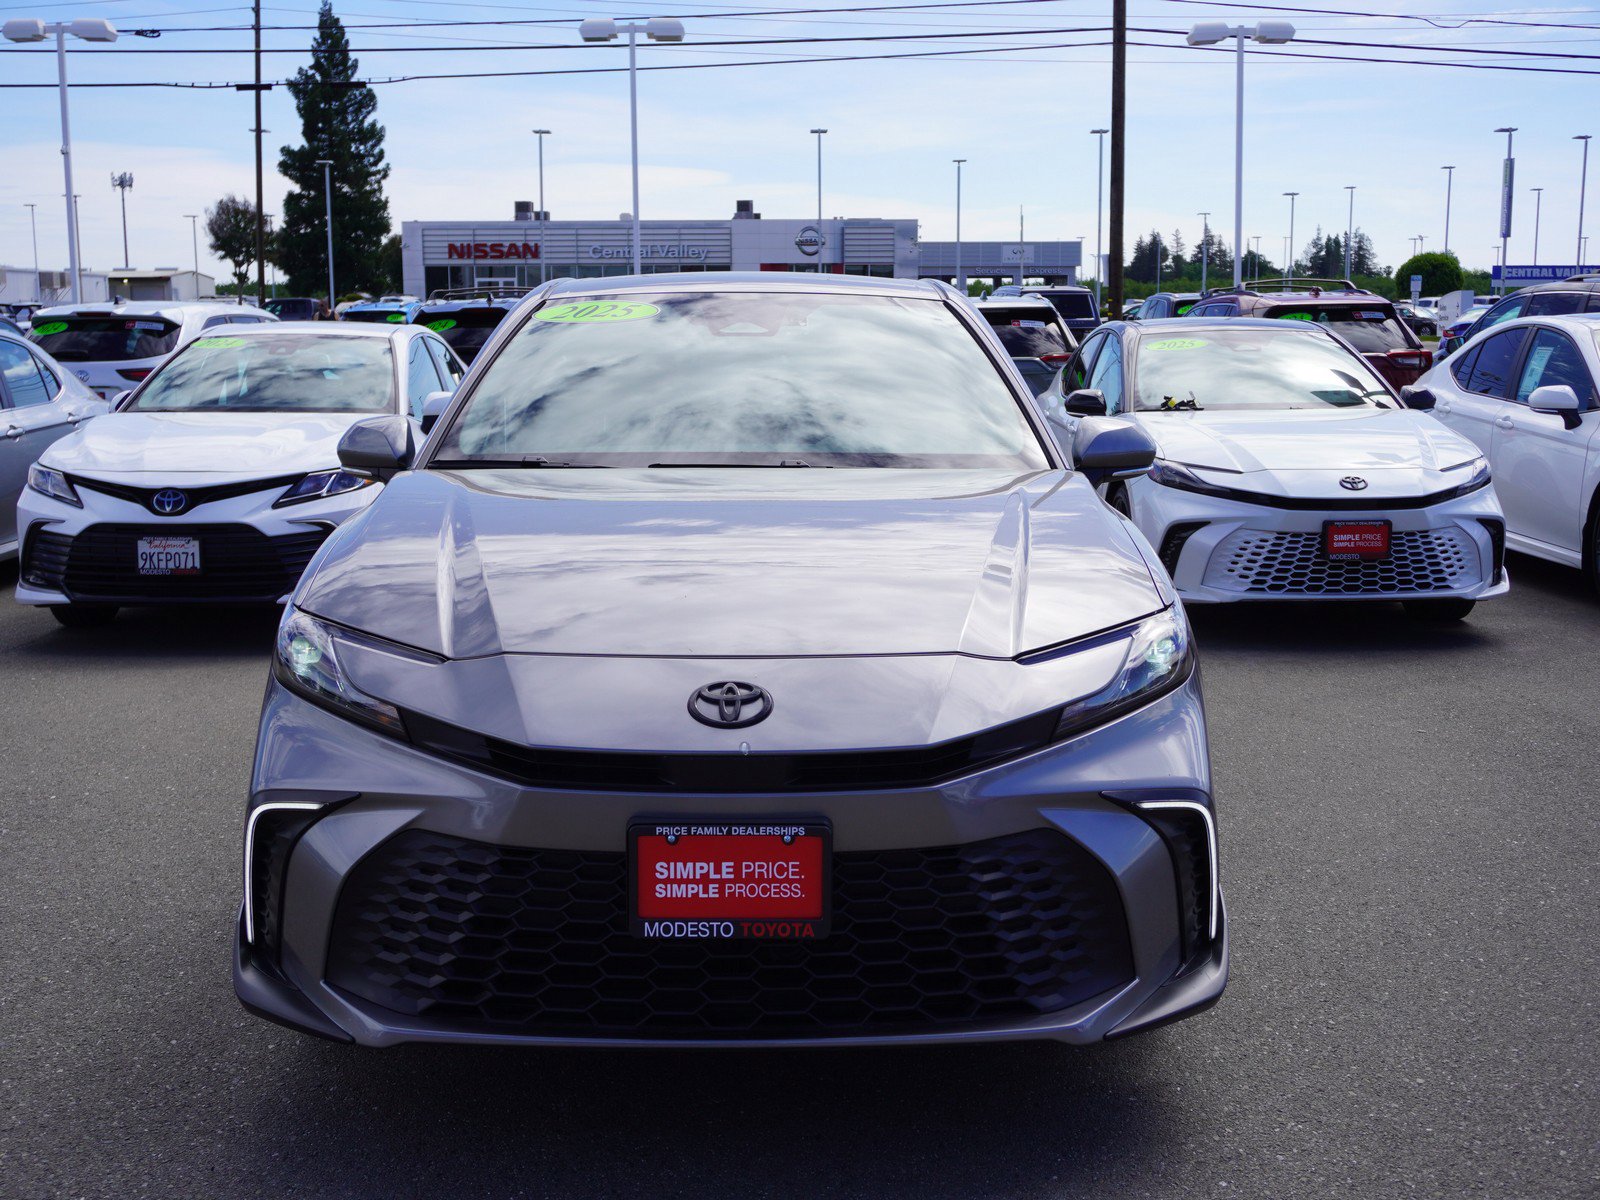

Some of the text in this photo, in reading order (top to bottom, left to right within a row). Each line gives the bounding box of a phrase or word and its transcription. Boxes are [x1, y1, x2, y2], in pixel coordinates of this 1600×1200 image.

[448, 243, 539, 259] NISSAN
[588, 244, 708, 261] Cental Valley
[975, 266, 1063, 276] Service Express
[1505, 268, 1554, 277] CENTRAL
[555, 304, 642, 320] 2025
[1158, 339, 1197, 350] 2025
[149, 541, 186, 551] California
[656, 827, 805, 836] PRICE FAMILY DEALERSHIPS
[655, 861, 805, 879] SIMPLE PRICE.
[655, 884, 805, 898] SIMPLE PROCESS.
[644, 922, 814, 938] MODESTO TOYOTA
